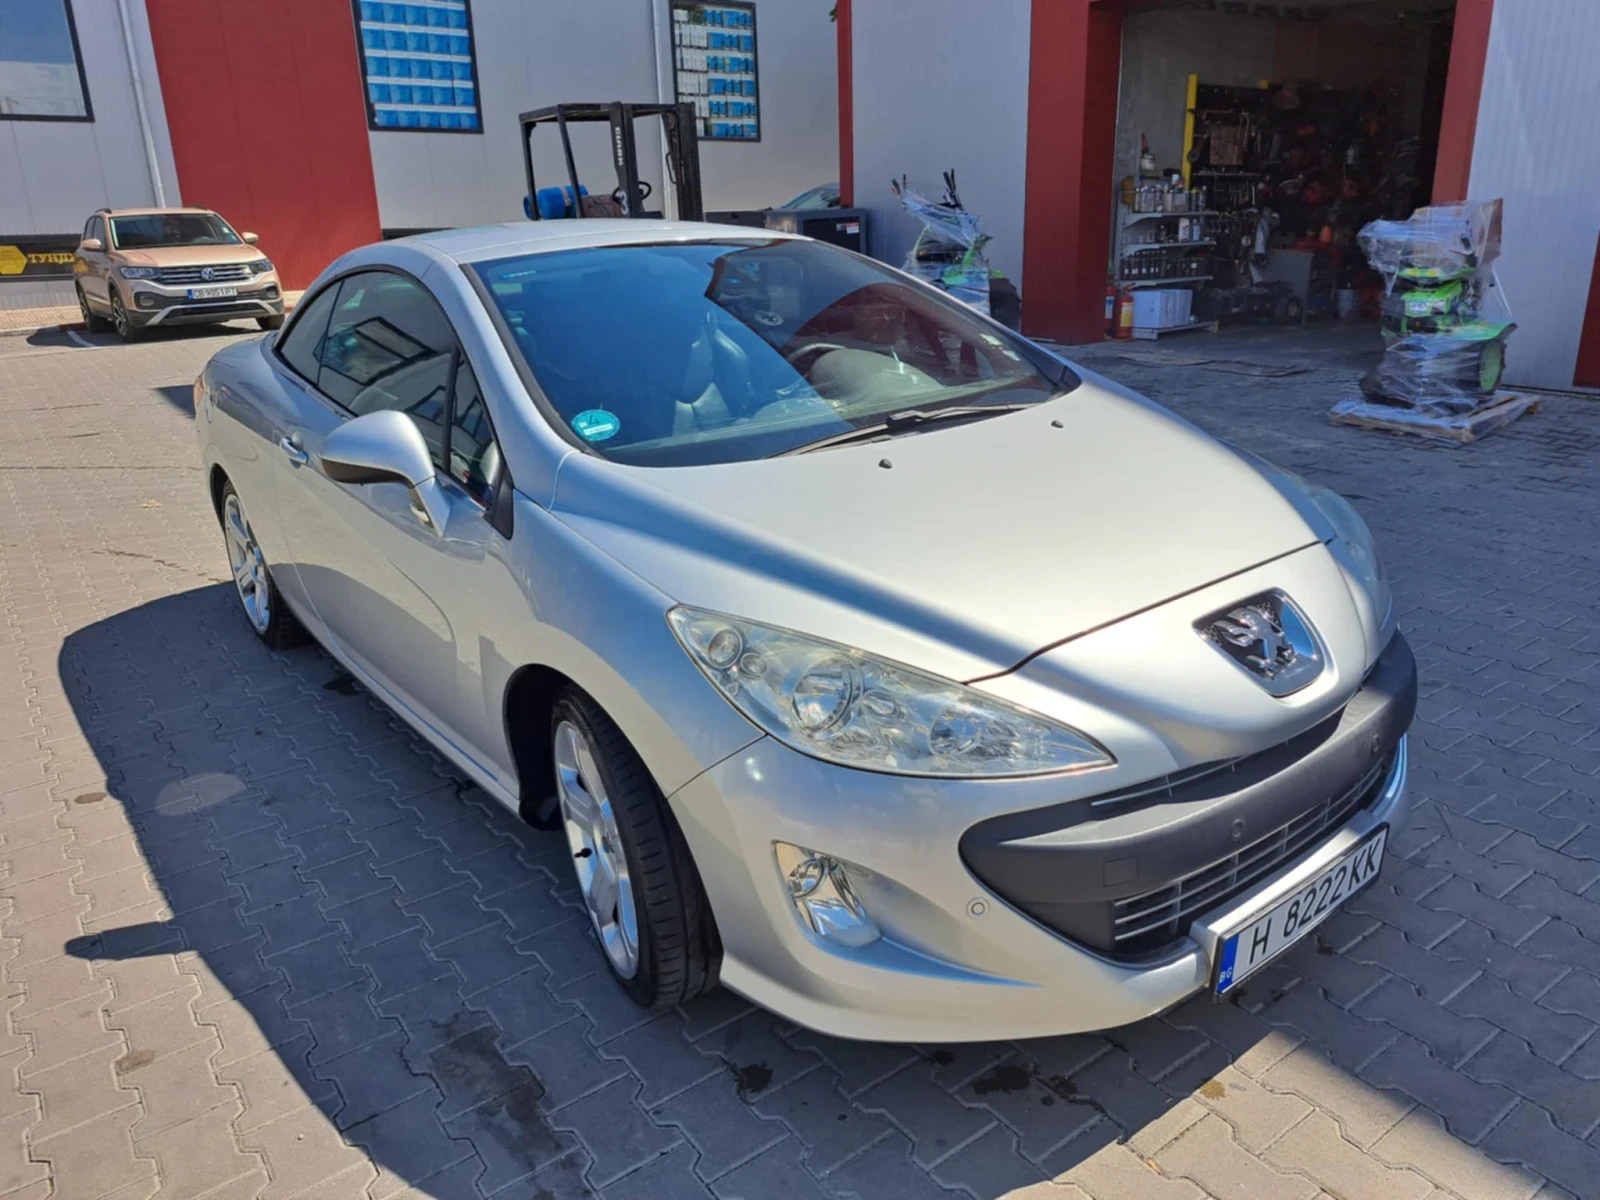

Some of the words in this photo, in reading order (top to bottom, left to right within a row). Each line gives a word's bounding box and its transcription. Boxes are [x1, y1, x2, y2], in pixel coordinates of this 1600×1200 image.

[614, 126, 625, 166] CLARK
[1249, 917, 1272, 965] H
[1219, 967, 1233, 983] BG
